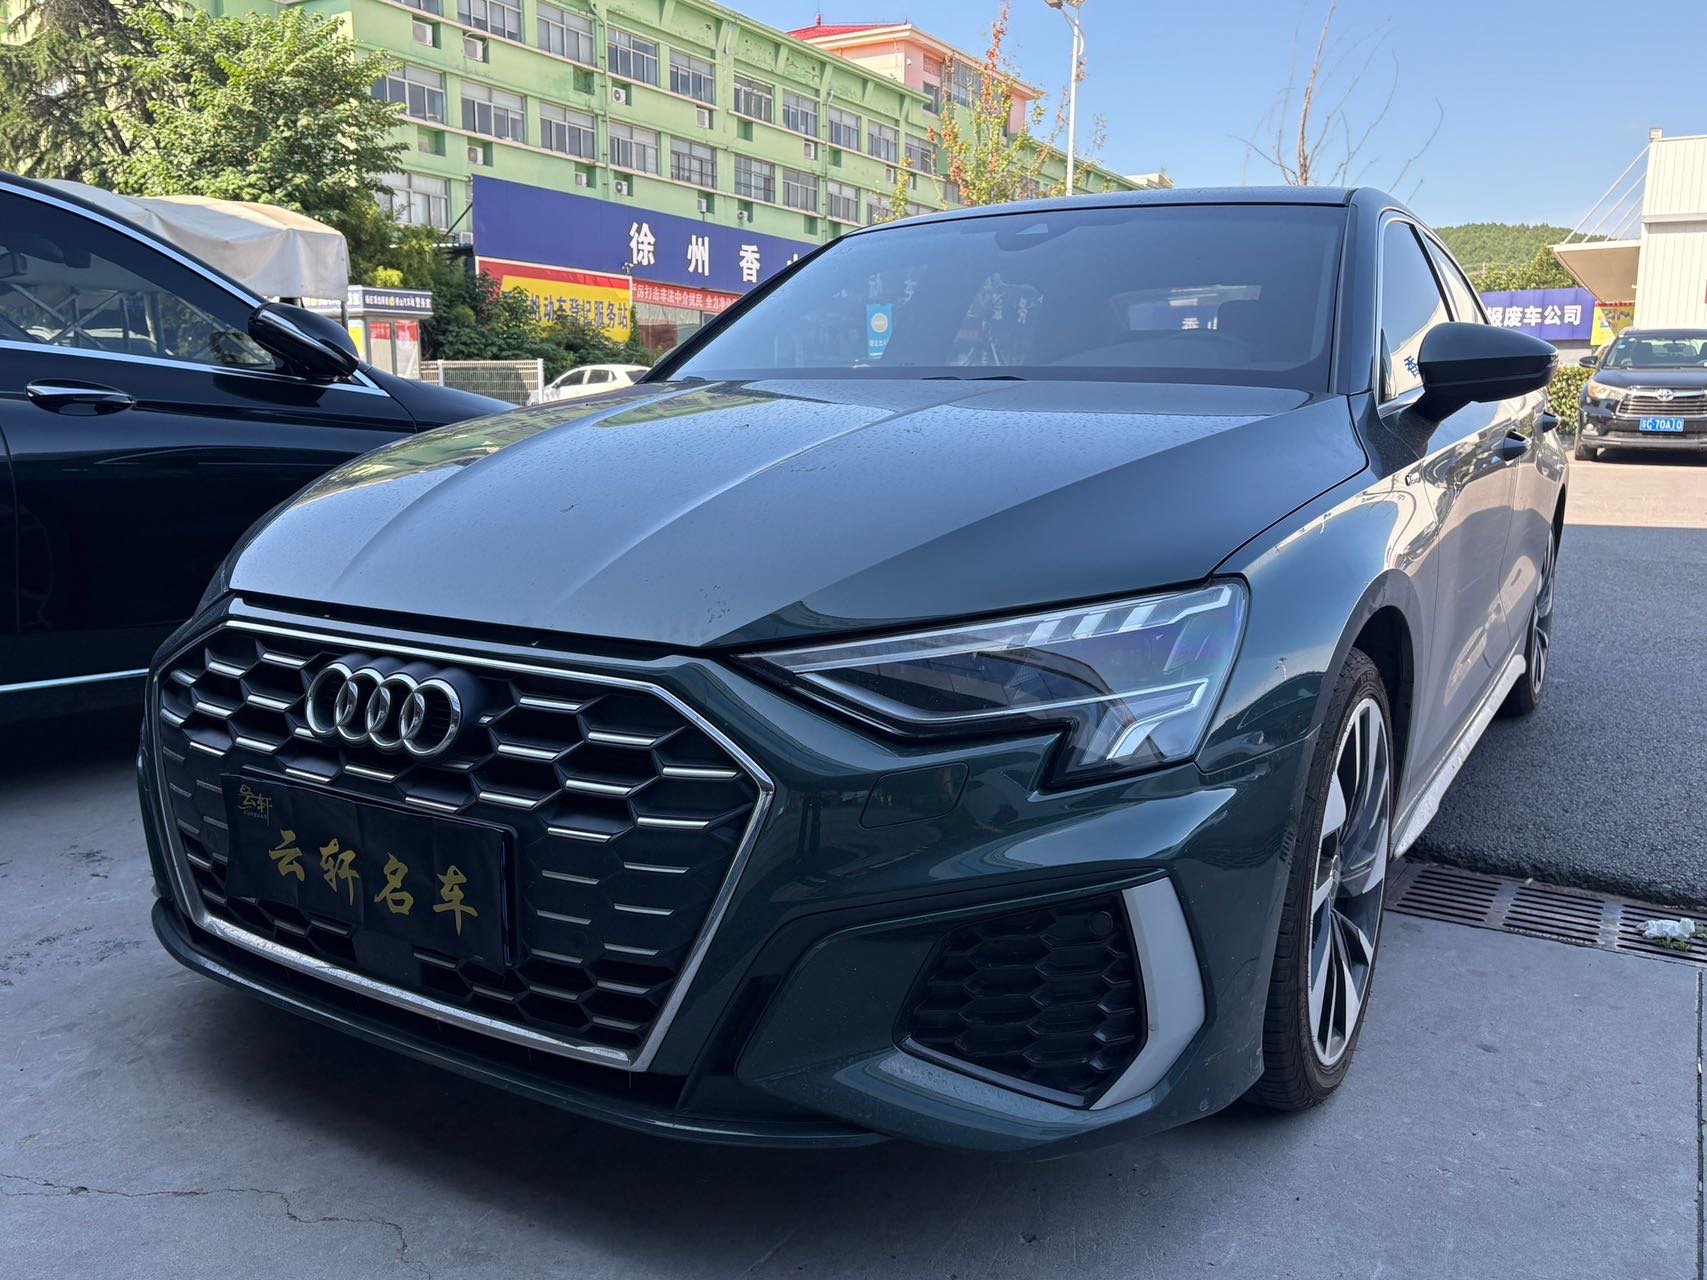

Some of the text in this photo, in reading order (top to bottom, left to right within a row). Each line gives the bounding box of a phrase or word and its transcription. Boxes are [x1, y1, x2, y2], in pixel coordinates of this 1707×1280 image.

[629, 222, 799, 283] 徐州香
[503, 289, 628, 329] 机动车登记服务站
[268, 828, 479, 937] 云轩名车
